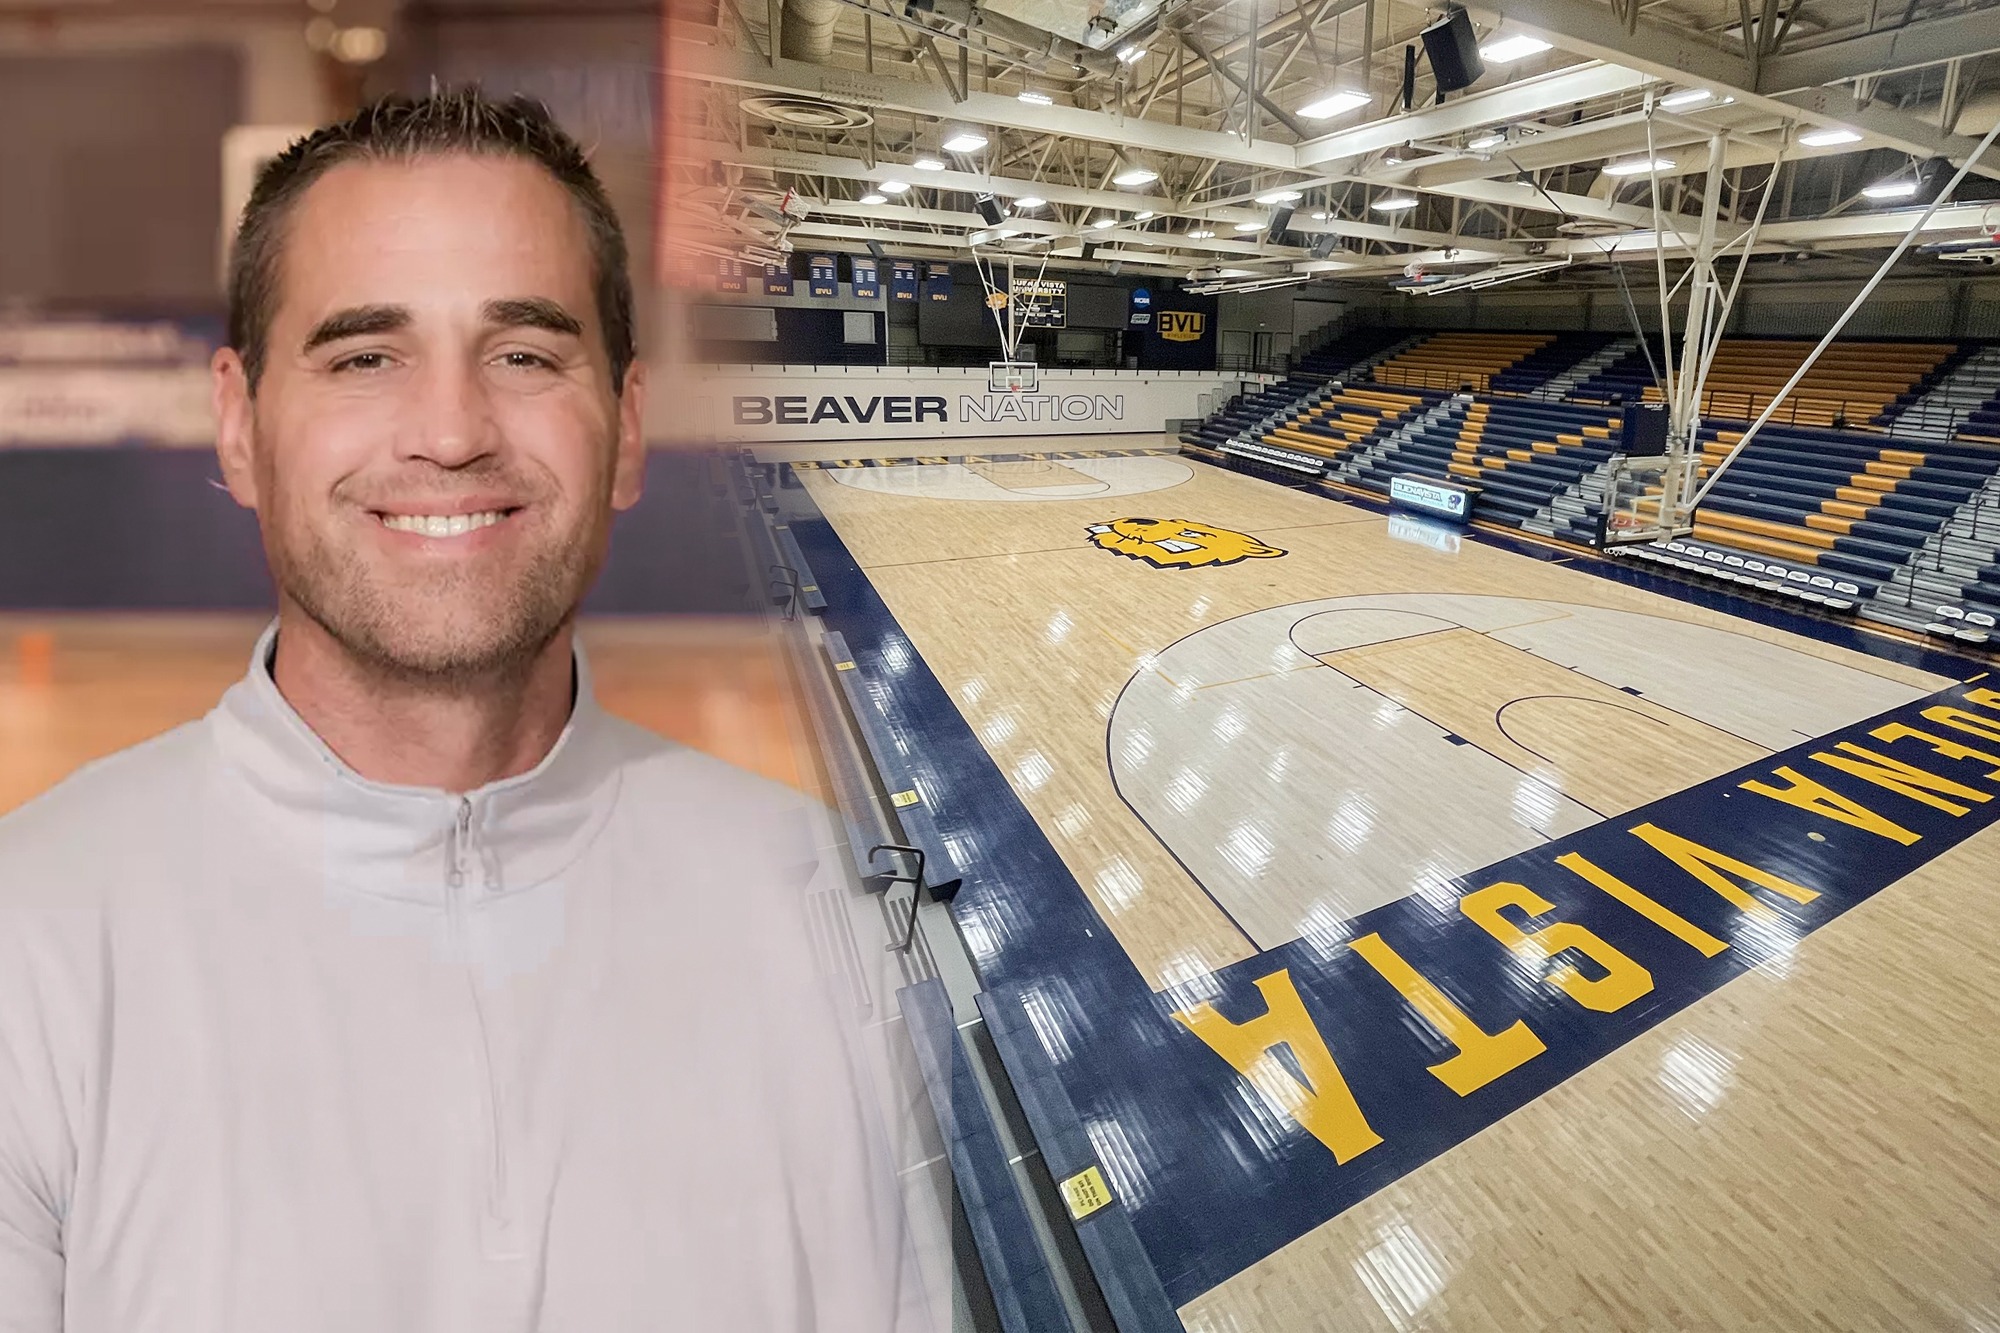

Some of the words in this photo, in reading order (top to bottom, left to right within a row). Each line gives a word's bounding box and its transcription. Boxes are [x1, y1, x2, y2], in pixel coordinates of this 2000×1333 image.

[769, 285, 787, 293] BVU
[815, 287, 832, 295] BVU
[1041, 281, 1065, 289] VISTA
[858, 289, 874, 297] BVU
[1158, 312, 1204, 333] BVU
[733, 396, 948, 425] BEAVER
[959, 395, 1123, 421] NATION
[789, 455, 993, 470] BUENA
[1737, 687, 2000, 847] UENA
[1171, 821, 1822, 1166] VISTA
